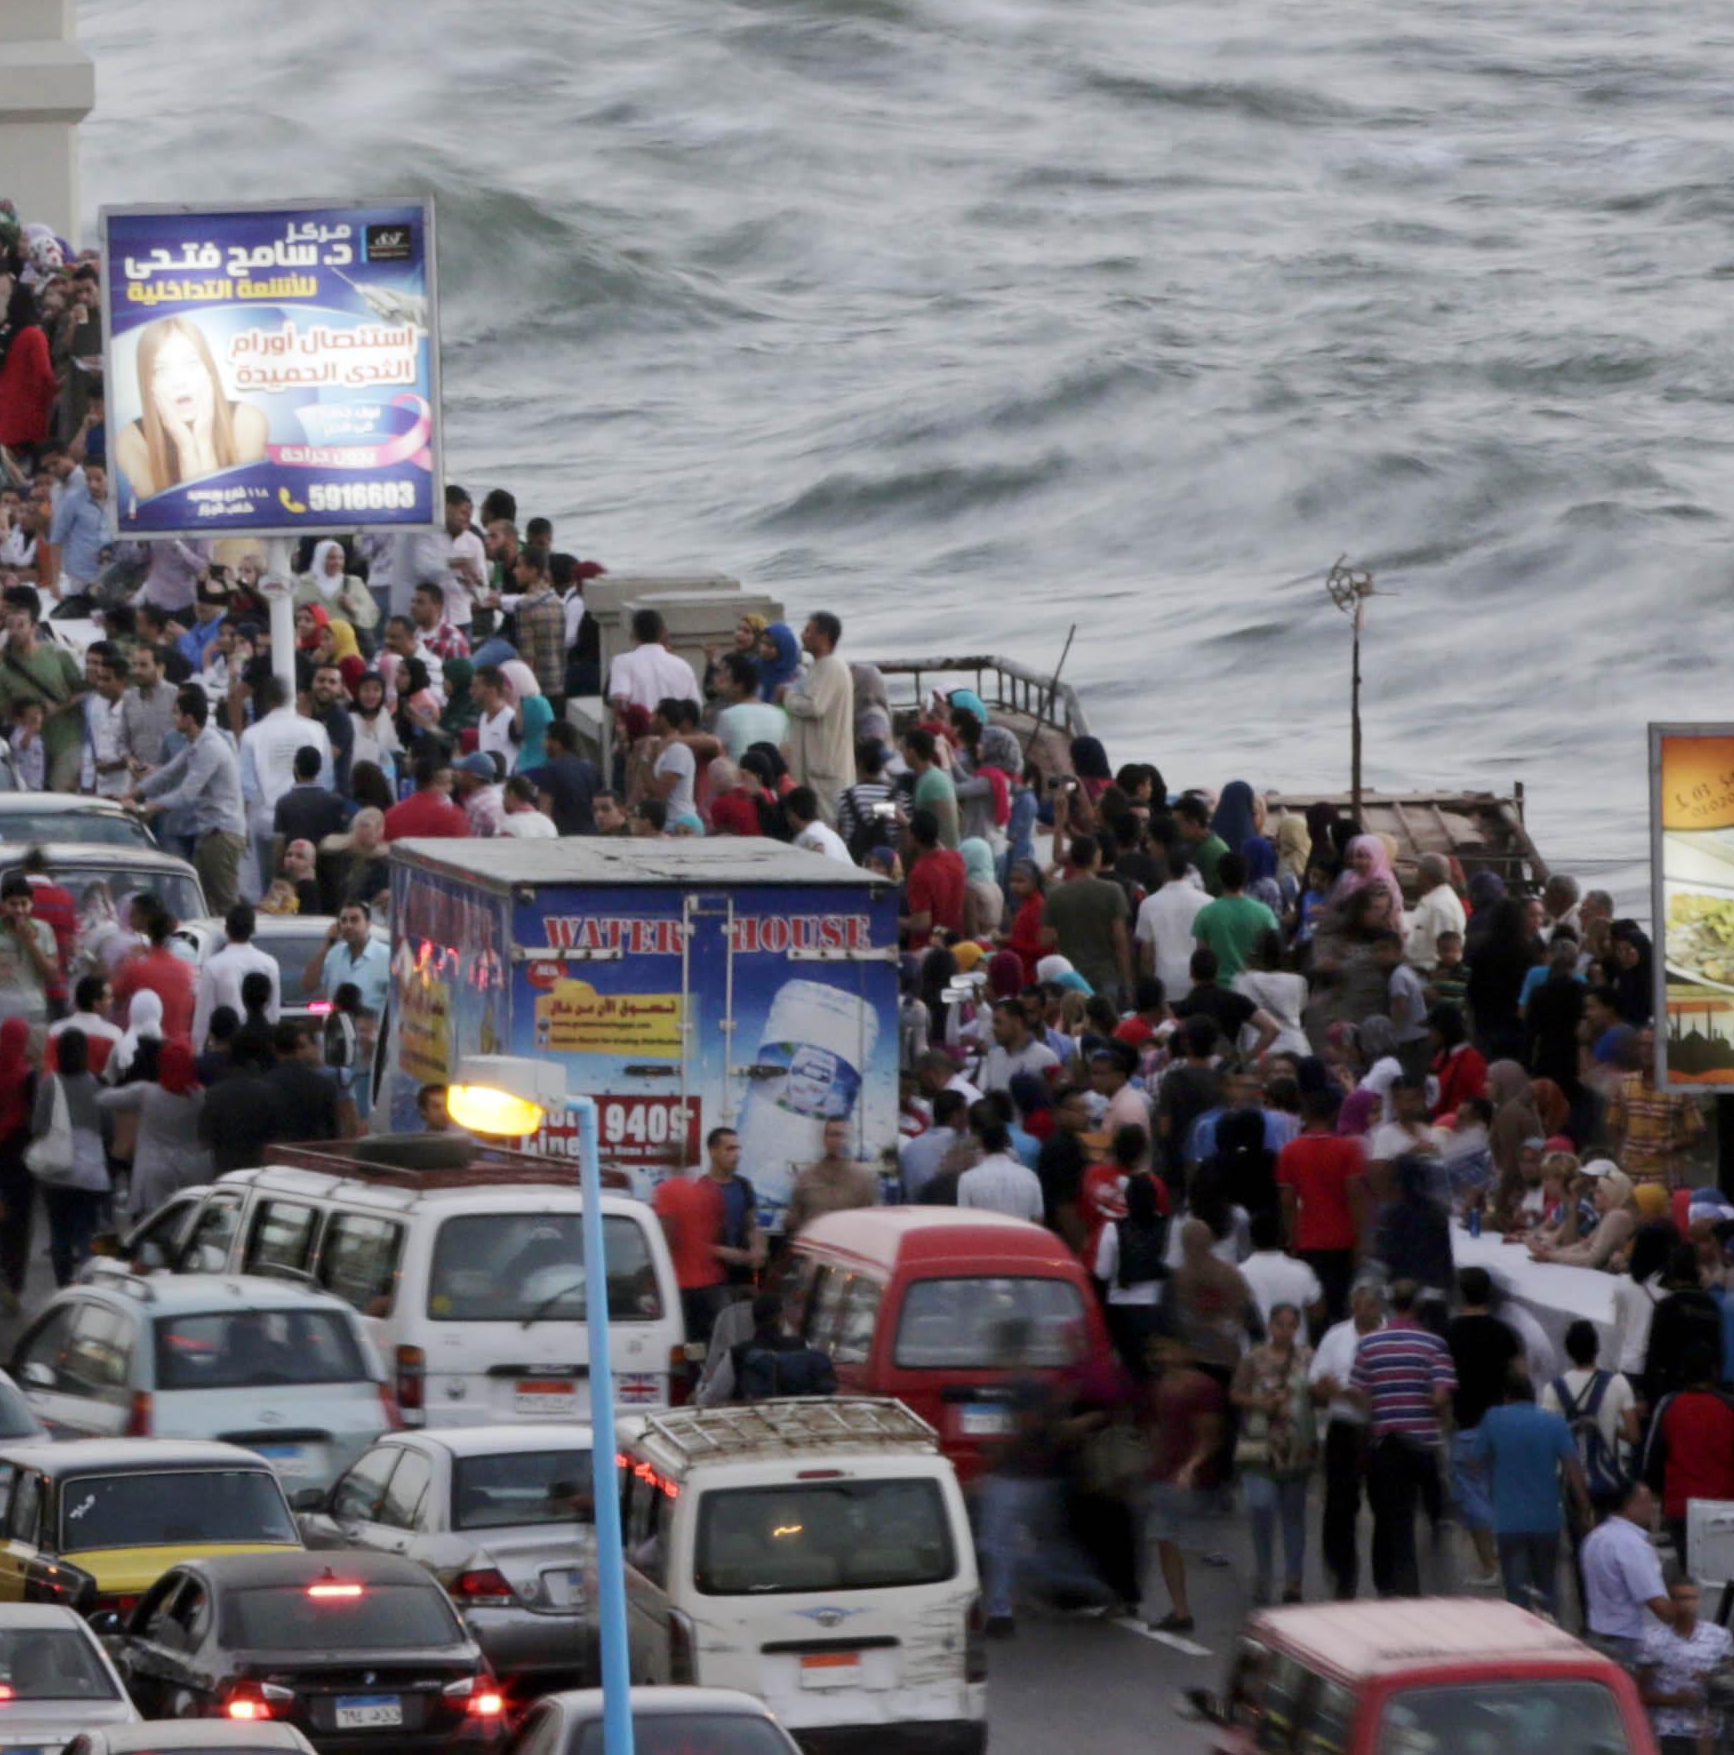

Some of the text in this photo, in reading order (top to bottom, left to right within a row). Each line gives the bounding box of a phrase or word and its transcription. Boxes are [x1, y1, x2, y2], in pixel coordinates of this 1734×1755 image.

[286, 221, 351, 244] مركز
[226, 240, 318, 277] سامح
[128, 272, 318, 305] للأشعة التداخلية
[231, 325, 294, 357] أورام
[236, 361, 337, 387] الحميدة
[308, 481, 416, 512] 5916603
[544, 913, 872, 954] WATER HOUSE
